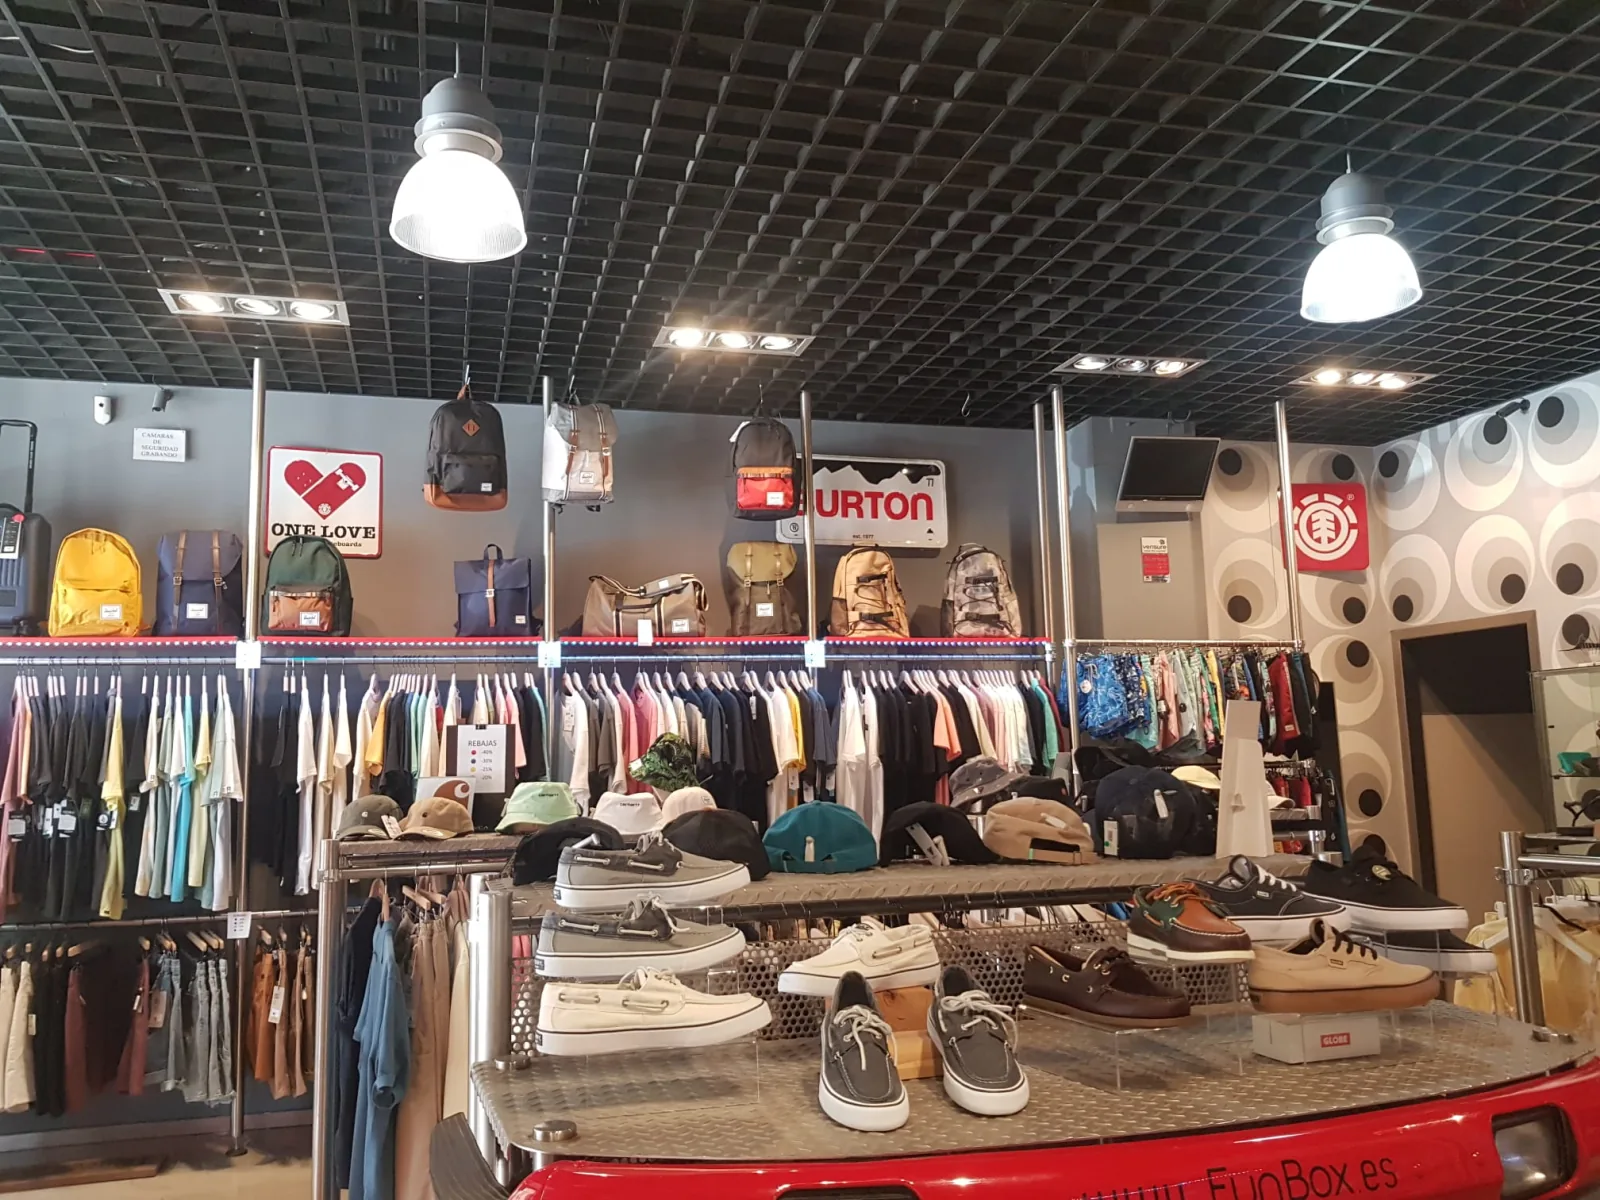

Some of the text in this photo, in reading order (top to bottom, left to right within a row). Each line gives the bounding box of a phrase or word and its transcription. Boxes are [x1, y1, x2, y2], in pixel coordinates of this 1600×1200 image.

[141, 444, 179, 452] SEGURIDAD
[800, 488, 934, 521] URTON
[271, 522, 376, 539] ONE LOVE
[1323, 1035, 1349, 1045] GLOBE
